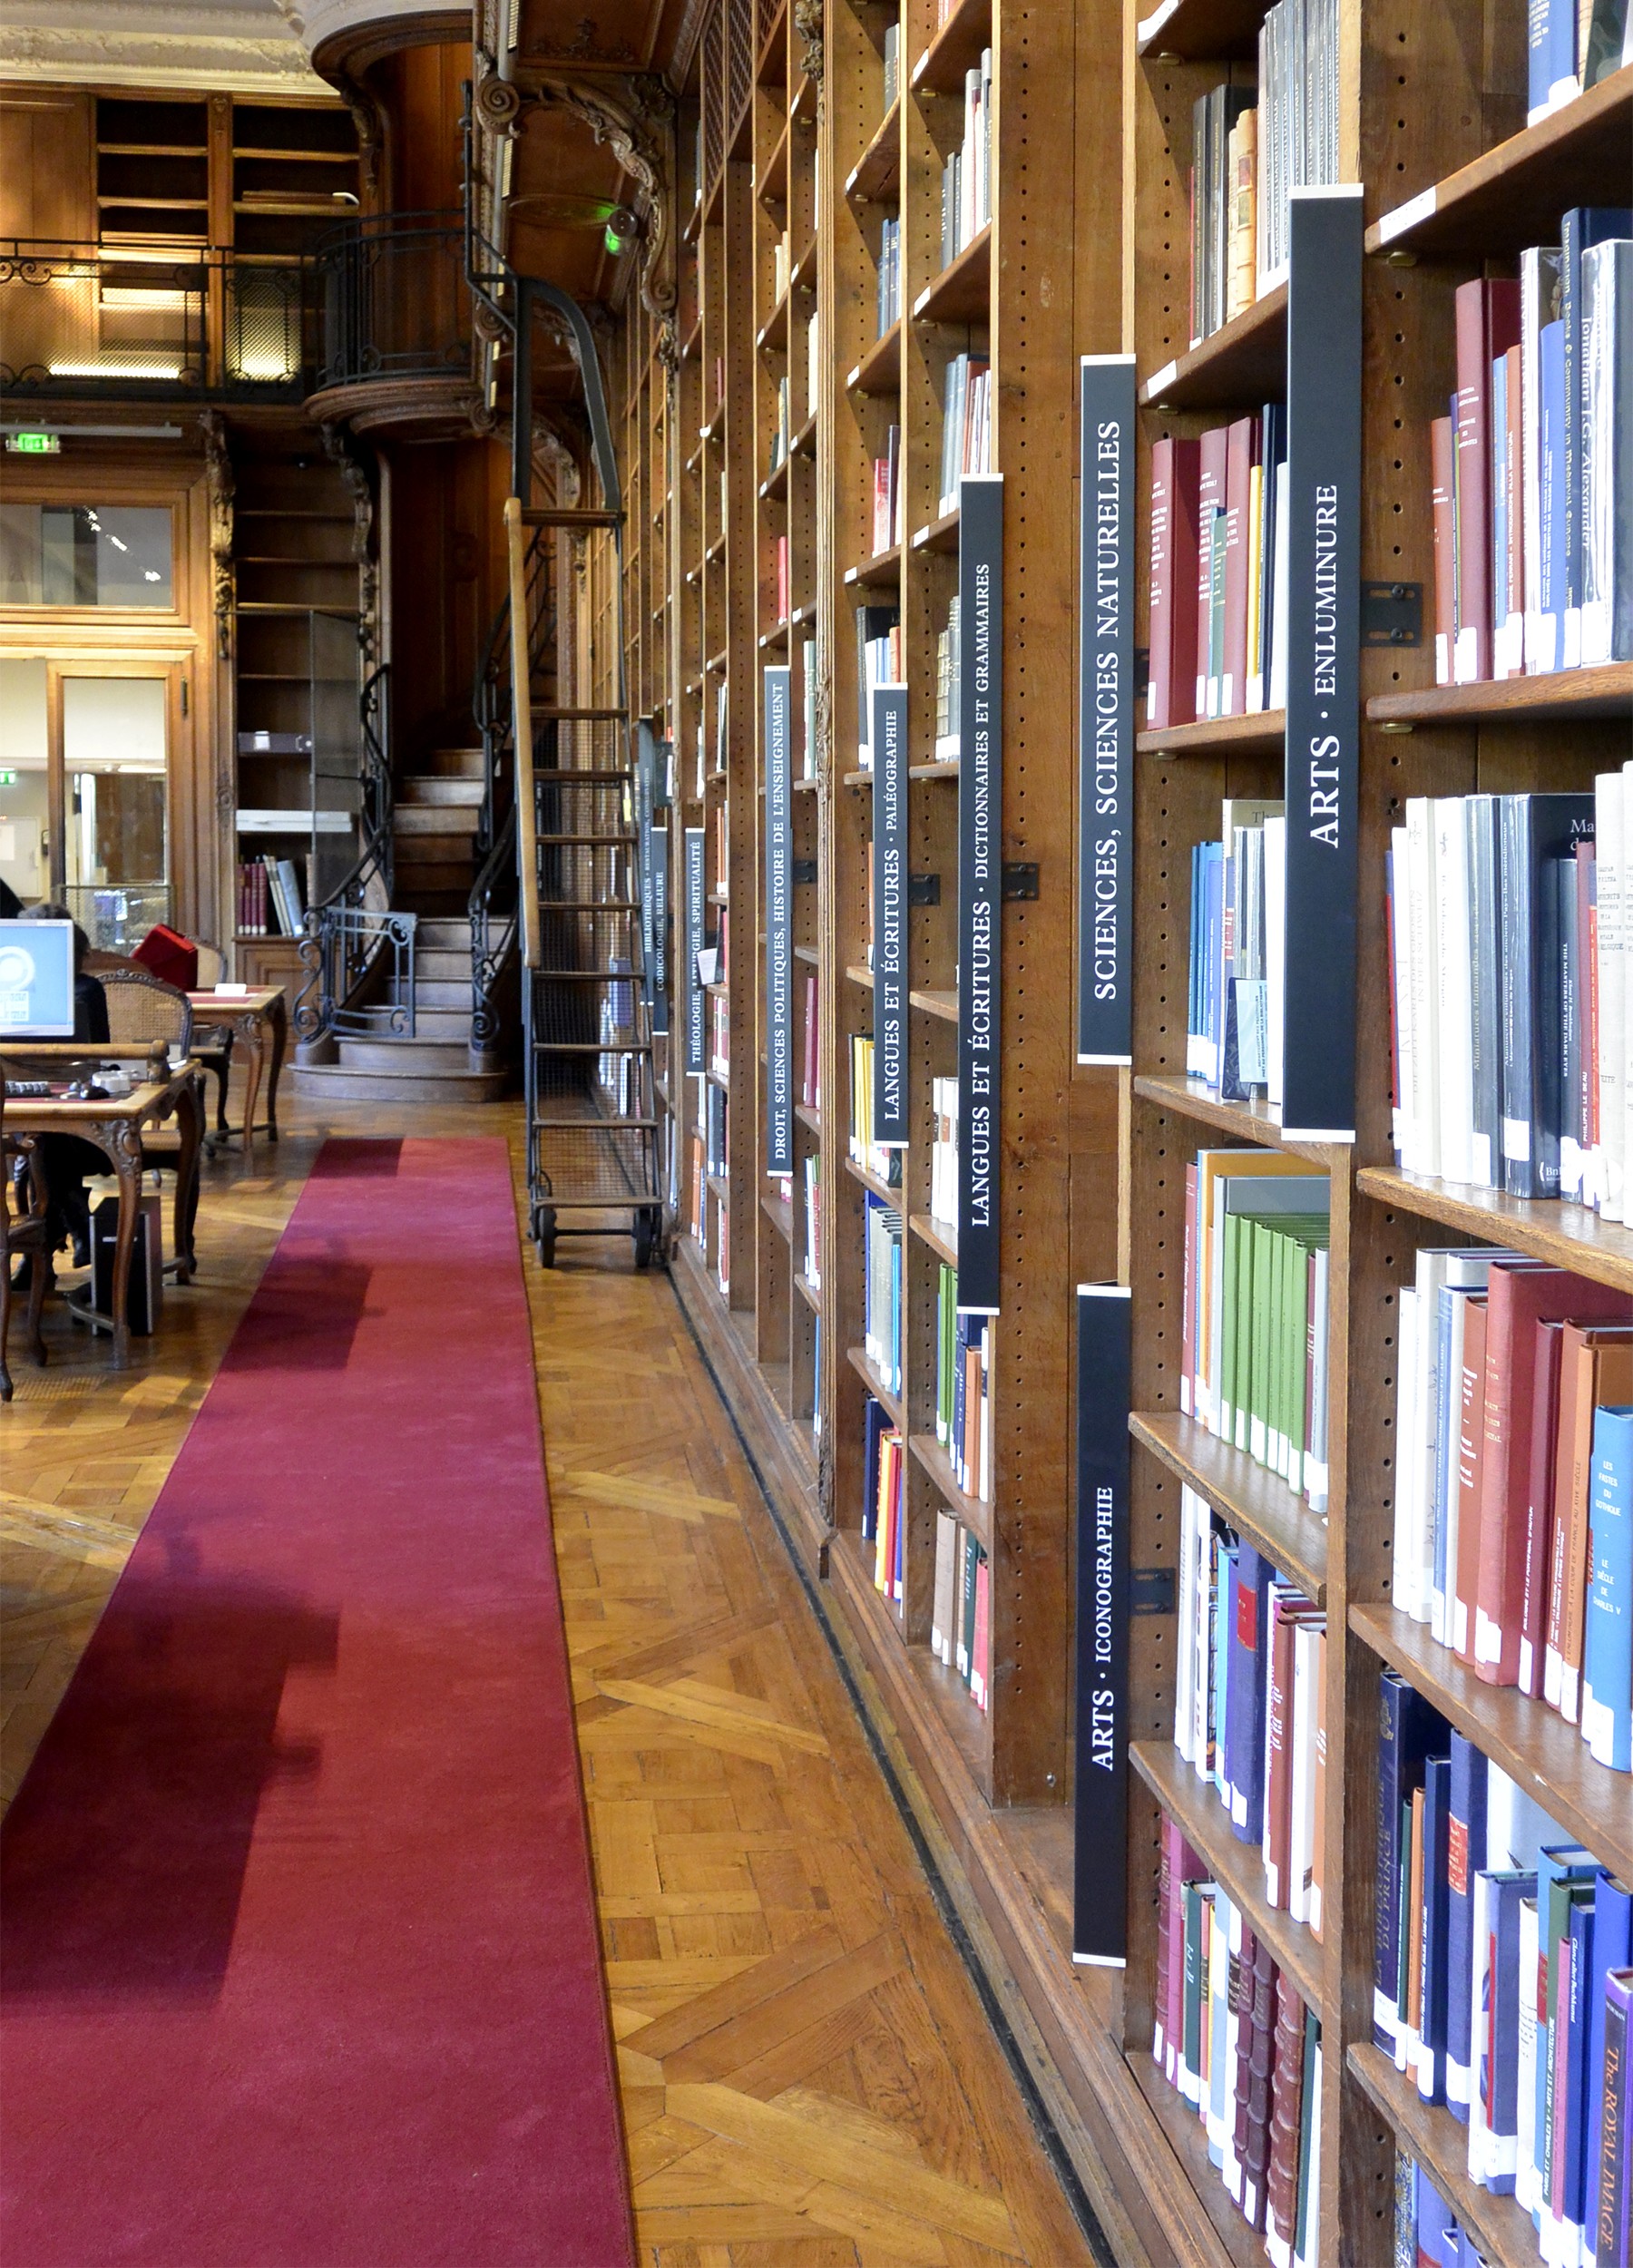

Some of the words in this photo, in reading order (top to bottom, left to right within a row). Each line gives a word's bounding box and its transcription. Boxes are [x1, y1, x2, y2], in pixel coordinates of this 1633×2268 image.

[1096, 421, 1120, 639] NATURELLES
[975, 563, 990, 692] GRAMMAIRES
[1314, 484, 1337, 697] ENLUMINURE
[770, 683, 786, 816] L'ENSEIGNEMENT
[975, 699, 989, 724] ET
[1095, 651, 1120, 815] SCIENCES
[883, 709, 897, 831] PALÉOGRAPHIE
[974, 730, 989, 879] DICTIONNAIRES
[1309, 735, 1340, 849] ARTS
[772, 820, 786, 843] DE
[655, 871, 665, 915] RELIURE
[689, 841, 701, 924] SPIRITUALITÉ
[772, 848, 786, 923] HISTOIRE
[881, 848, 900, 974] ÉCRITURES
[1093, 828, 1122, 1000] SCIENCES,
[655, 918, 666, 992] CODICOLOGIE,
[773, 927, 787, 1023] POLITIQUES,
[884, 982, 900, 1011] ET
[967, 901, 991, 1051] ÉCRITURES
[689, 991, 703, 1063] THÉOLOGIE,
[773, 1029, 787, 1103] SCIENCES
[884, 1019, 900, 1120] LANGUES
[972, 1061, 990, 1095] ET
[774, 1109, 787, 1160] DROIT,
[971, 1106, 991, 1227] LANGUES
[1545, 1166, 1561, 1177] Bn
[1095, 1487, 1113, 1663] ICONOGRAPHIE
[1091, 1689, 1114, 1772] ARTS
[1606, 2047, 1619, 2086] The
[1604, 2088, 1618, 2164] ROYAL
[1600, 2166, 1616, 2251] IMAGE
